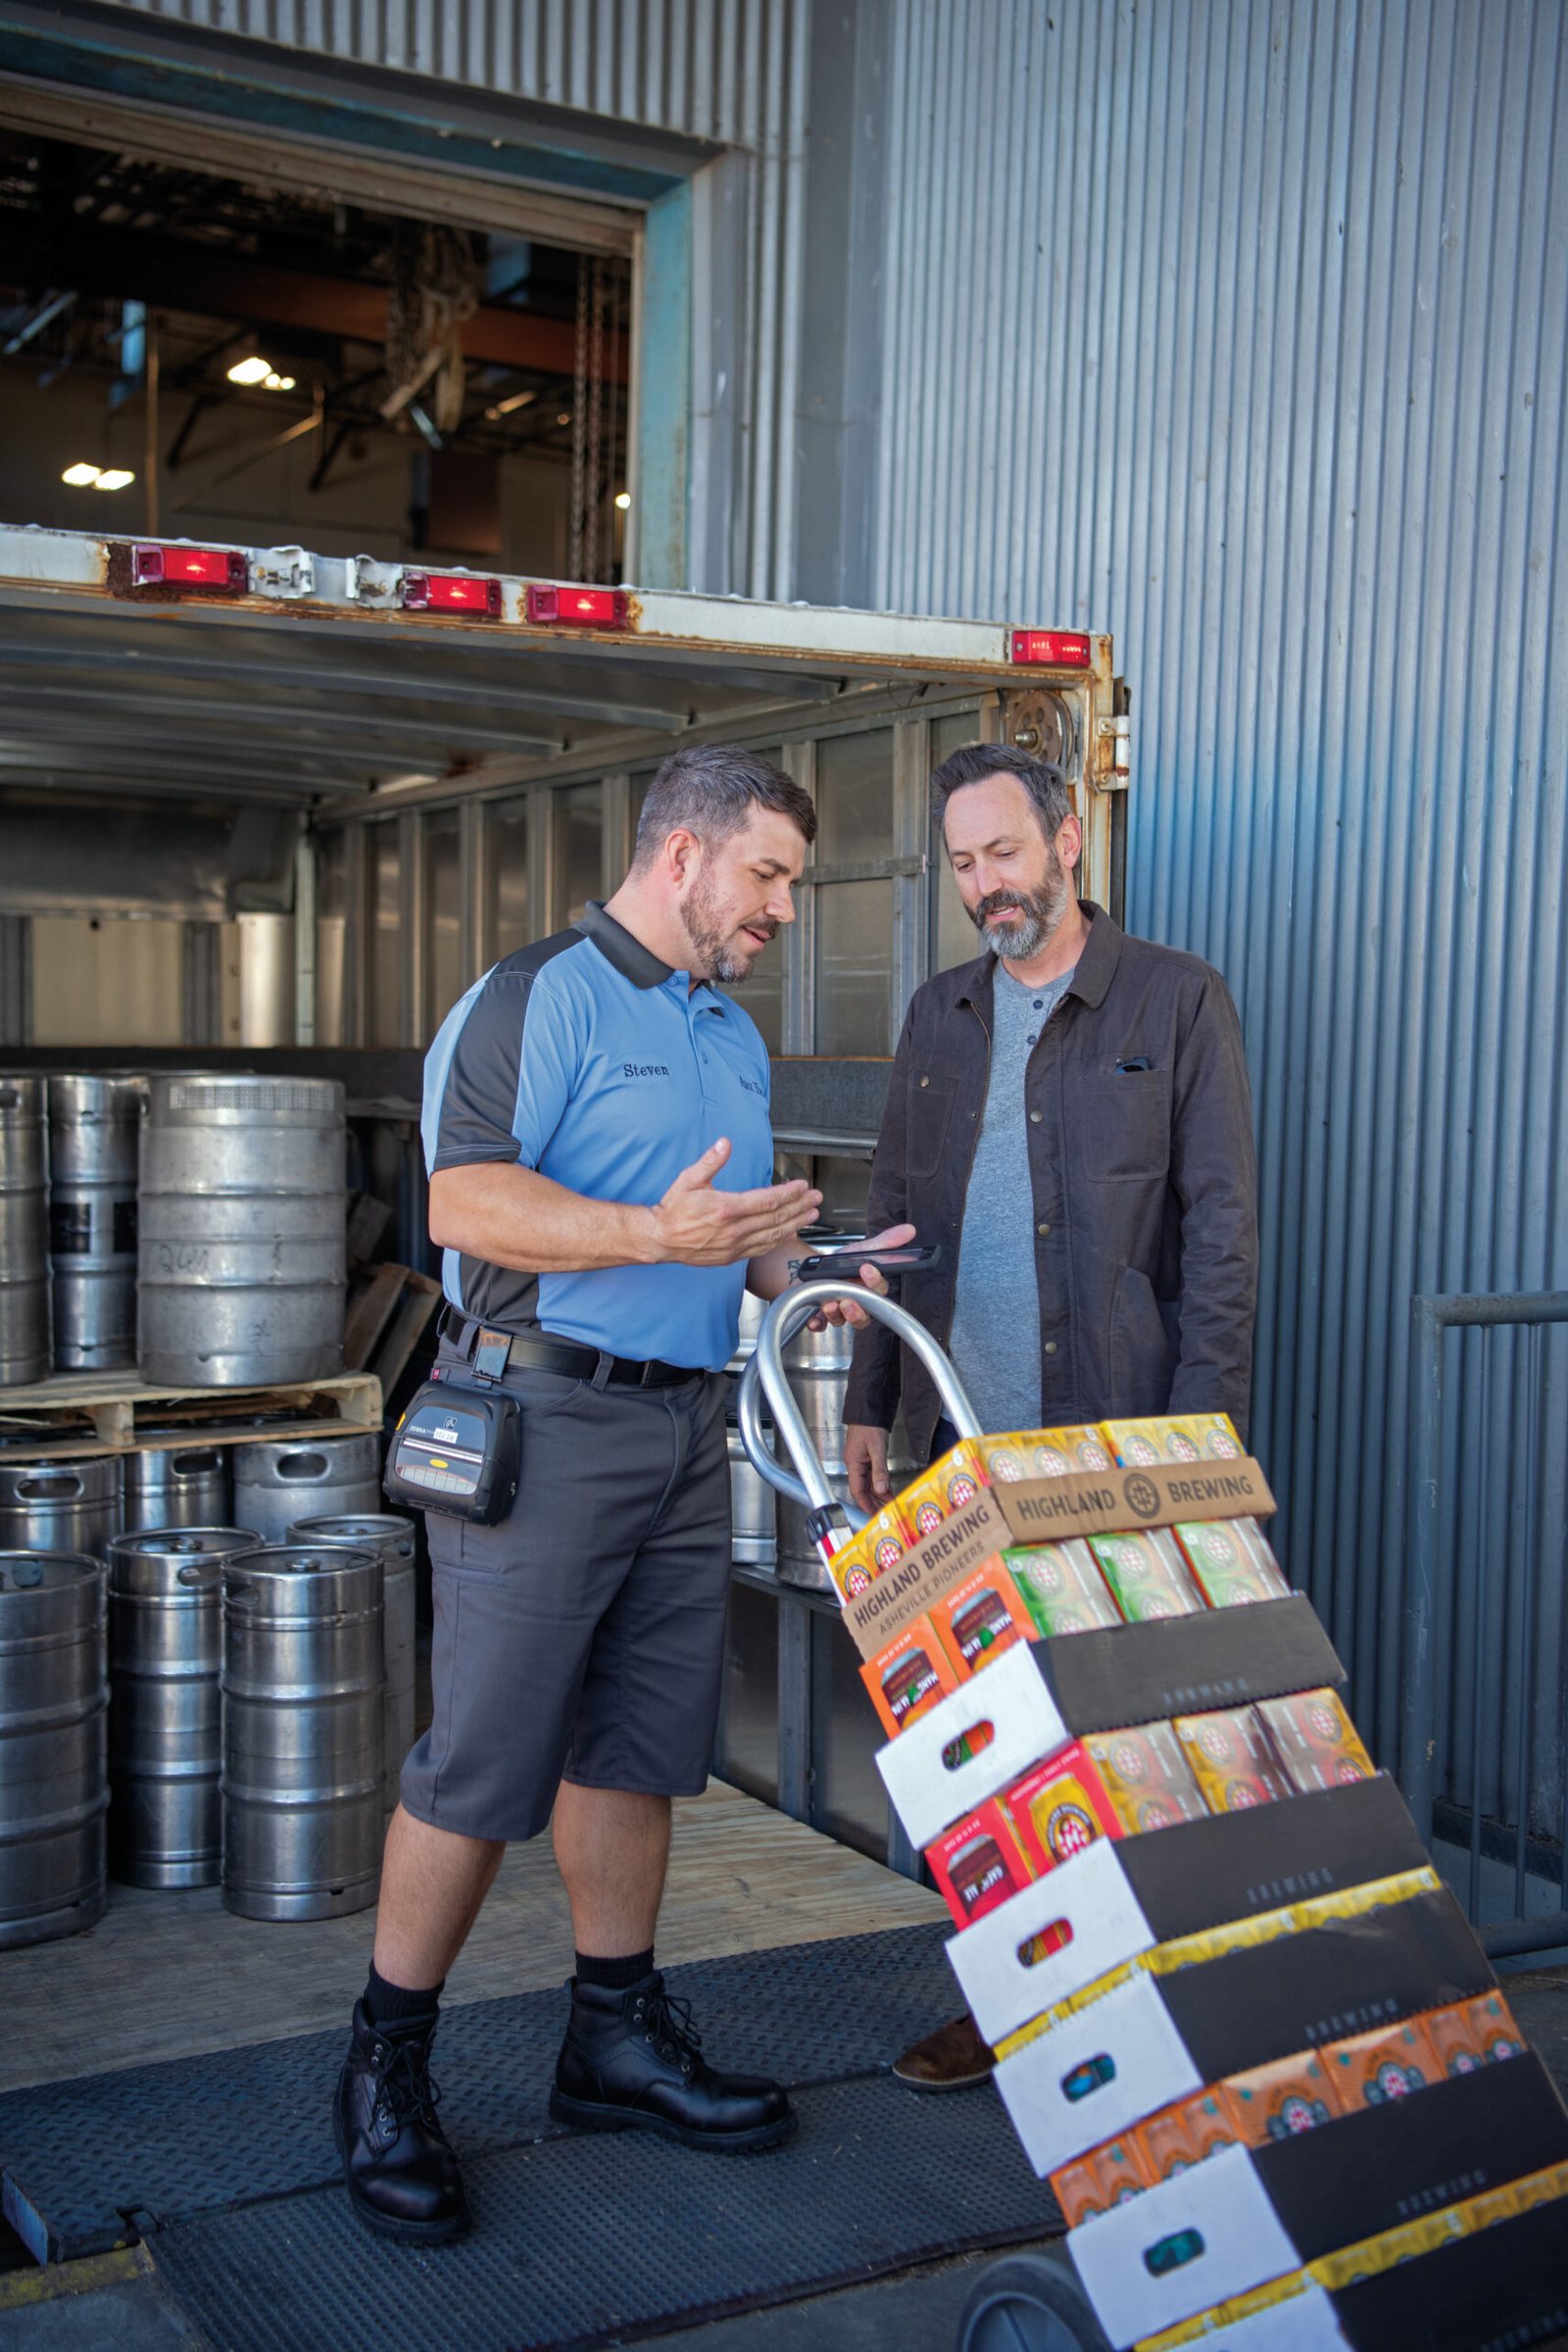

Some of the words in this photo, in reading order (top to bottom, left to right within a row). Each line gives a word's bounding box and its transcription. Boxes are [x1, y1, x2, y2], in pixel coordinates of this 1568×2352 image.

[623, 1063, 669, 1078] Steven
[953, 1448, 963, 1467] 6
[1016, 1488, 1116, 1521] HIGHLAND
[1167, 1475, 1254, 1503] BREWING
[879, 1511, 890, 1530] 6
[854, 1563, 921, 1628] HIGHLAND
[921, 1504, 990, 1570] BREWING
[879, 1583, 933, 1634] ASHEVILLE
[932, 1541, 985, 1589] PIONEERS
